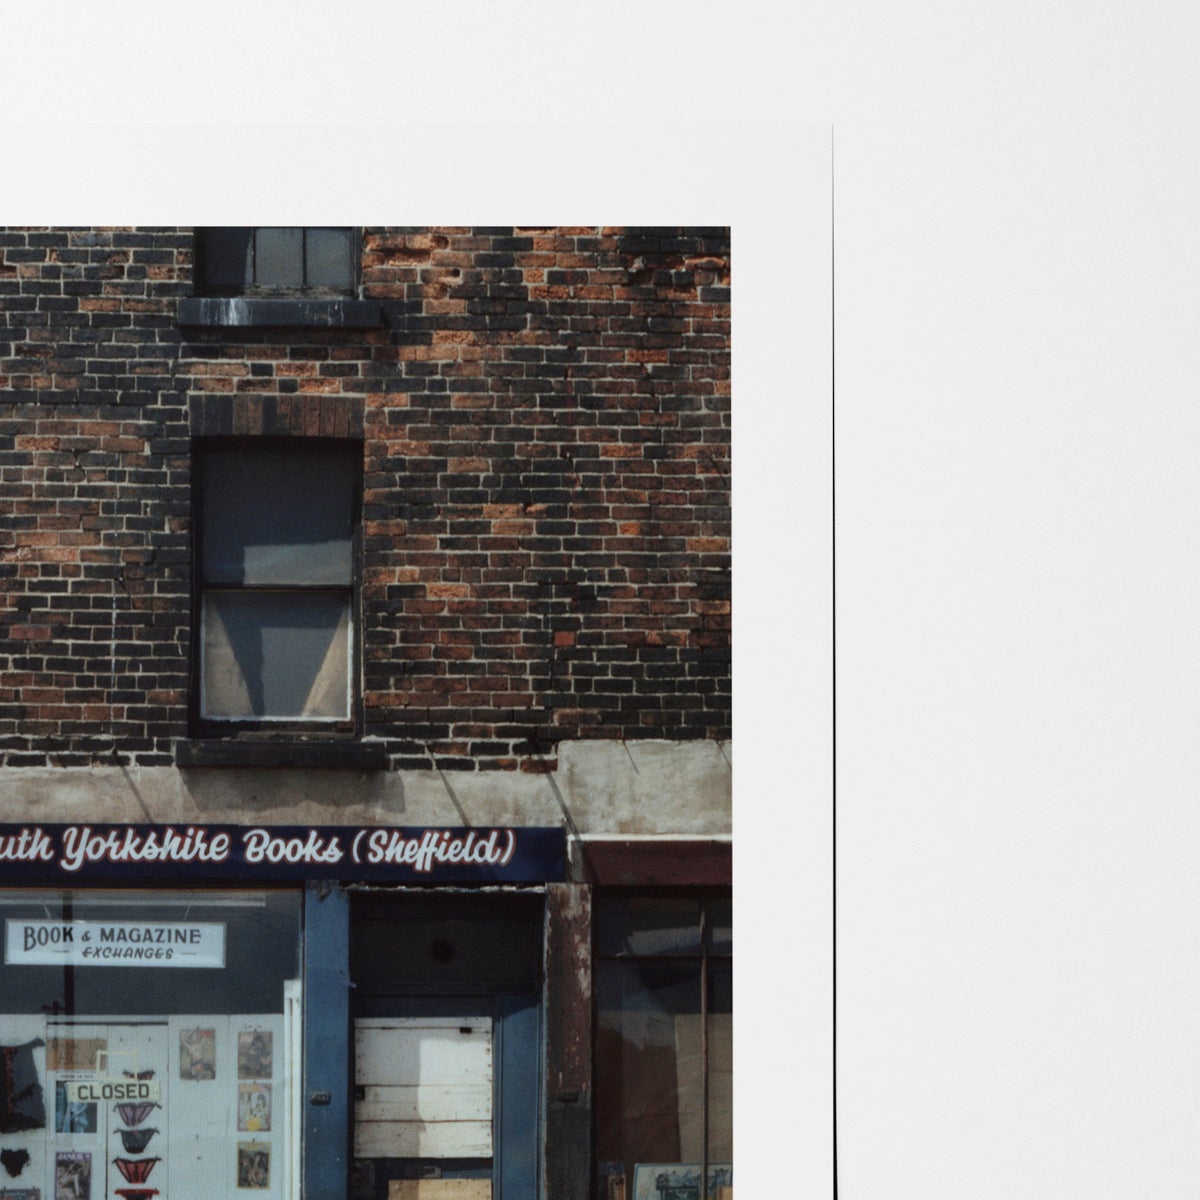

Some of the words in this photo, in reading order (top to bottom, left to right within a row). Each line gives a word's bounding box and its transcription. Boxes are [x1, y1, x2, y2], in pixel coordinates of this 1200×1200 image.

[59, 826, 230, 872] Yorkshire
[242, 828, 344, 863] Books
[351, 828, 517, 873] (Sheffield)
[24, 926, 74, 951] BOOK
[81, 930, 92, 942] &
[100, 927, 202, 944] MAGAZINE
[81, 946, 175, 960] EXCHANGES
[77, 1083, 150, 1101] CLOSED
